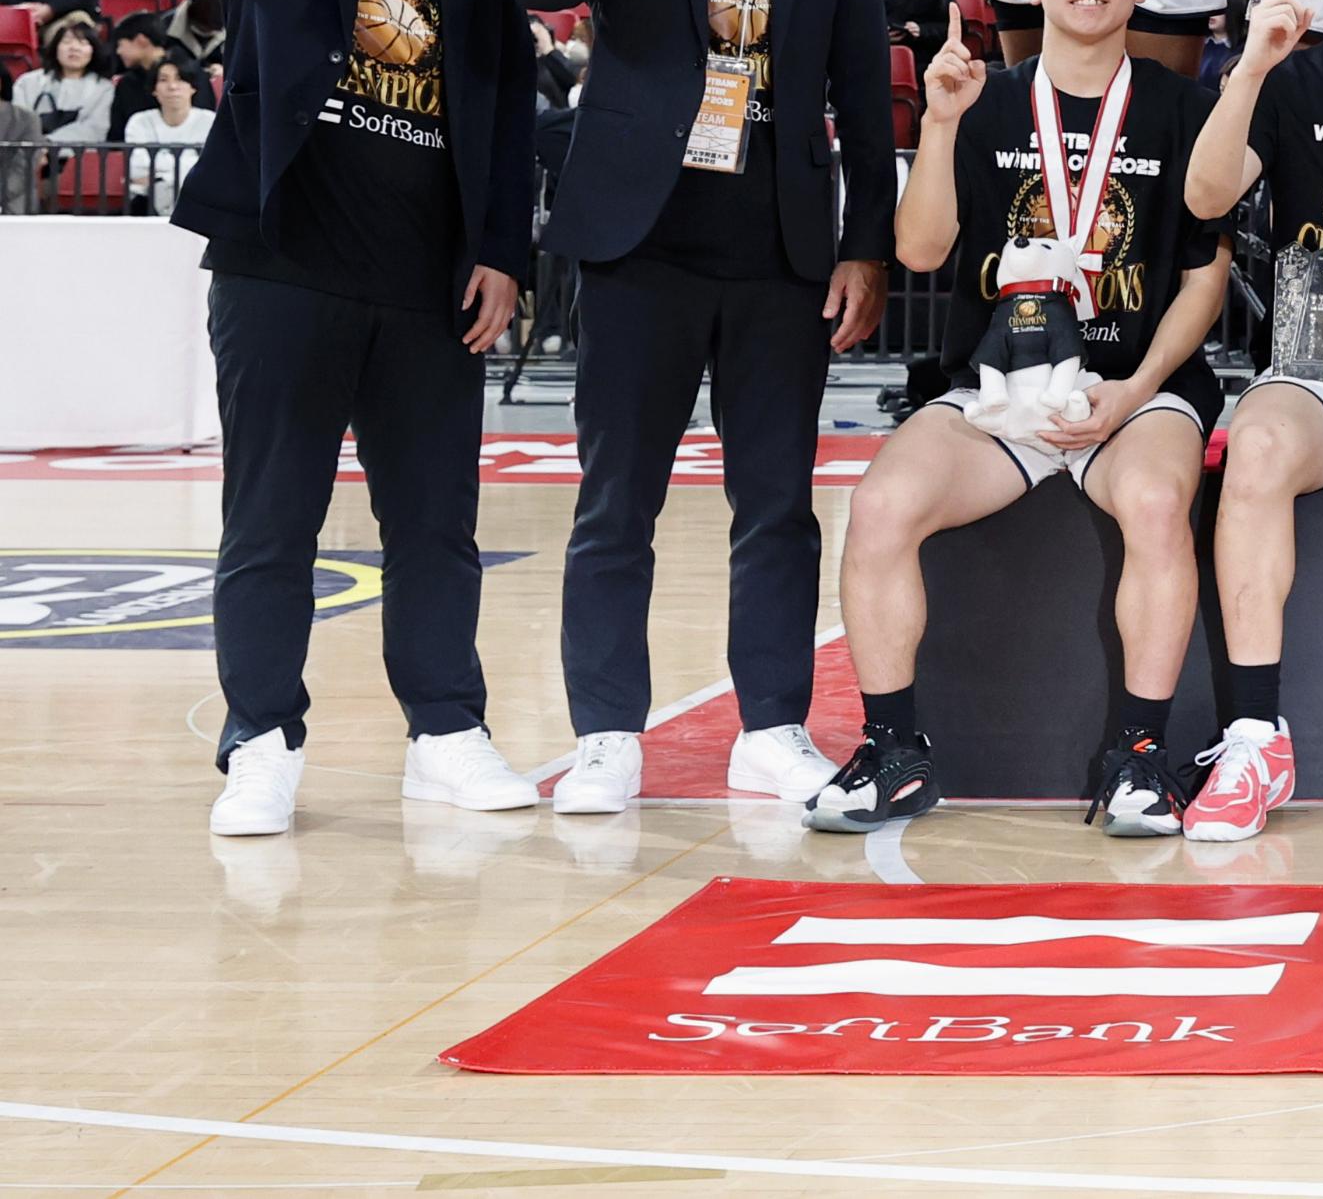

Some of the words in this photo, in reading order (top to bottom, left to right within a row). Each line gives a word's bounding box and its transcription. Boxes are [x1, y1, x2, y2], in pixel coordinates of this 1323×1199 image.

[349, 105, 446, 149] SoftBank
[696, 112, 726, 126] TEAM
[1110, 157, 1161, 177] 2025
[646, 1012, 1236, 1045] SoftBank
